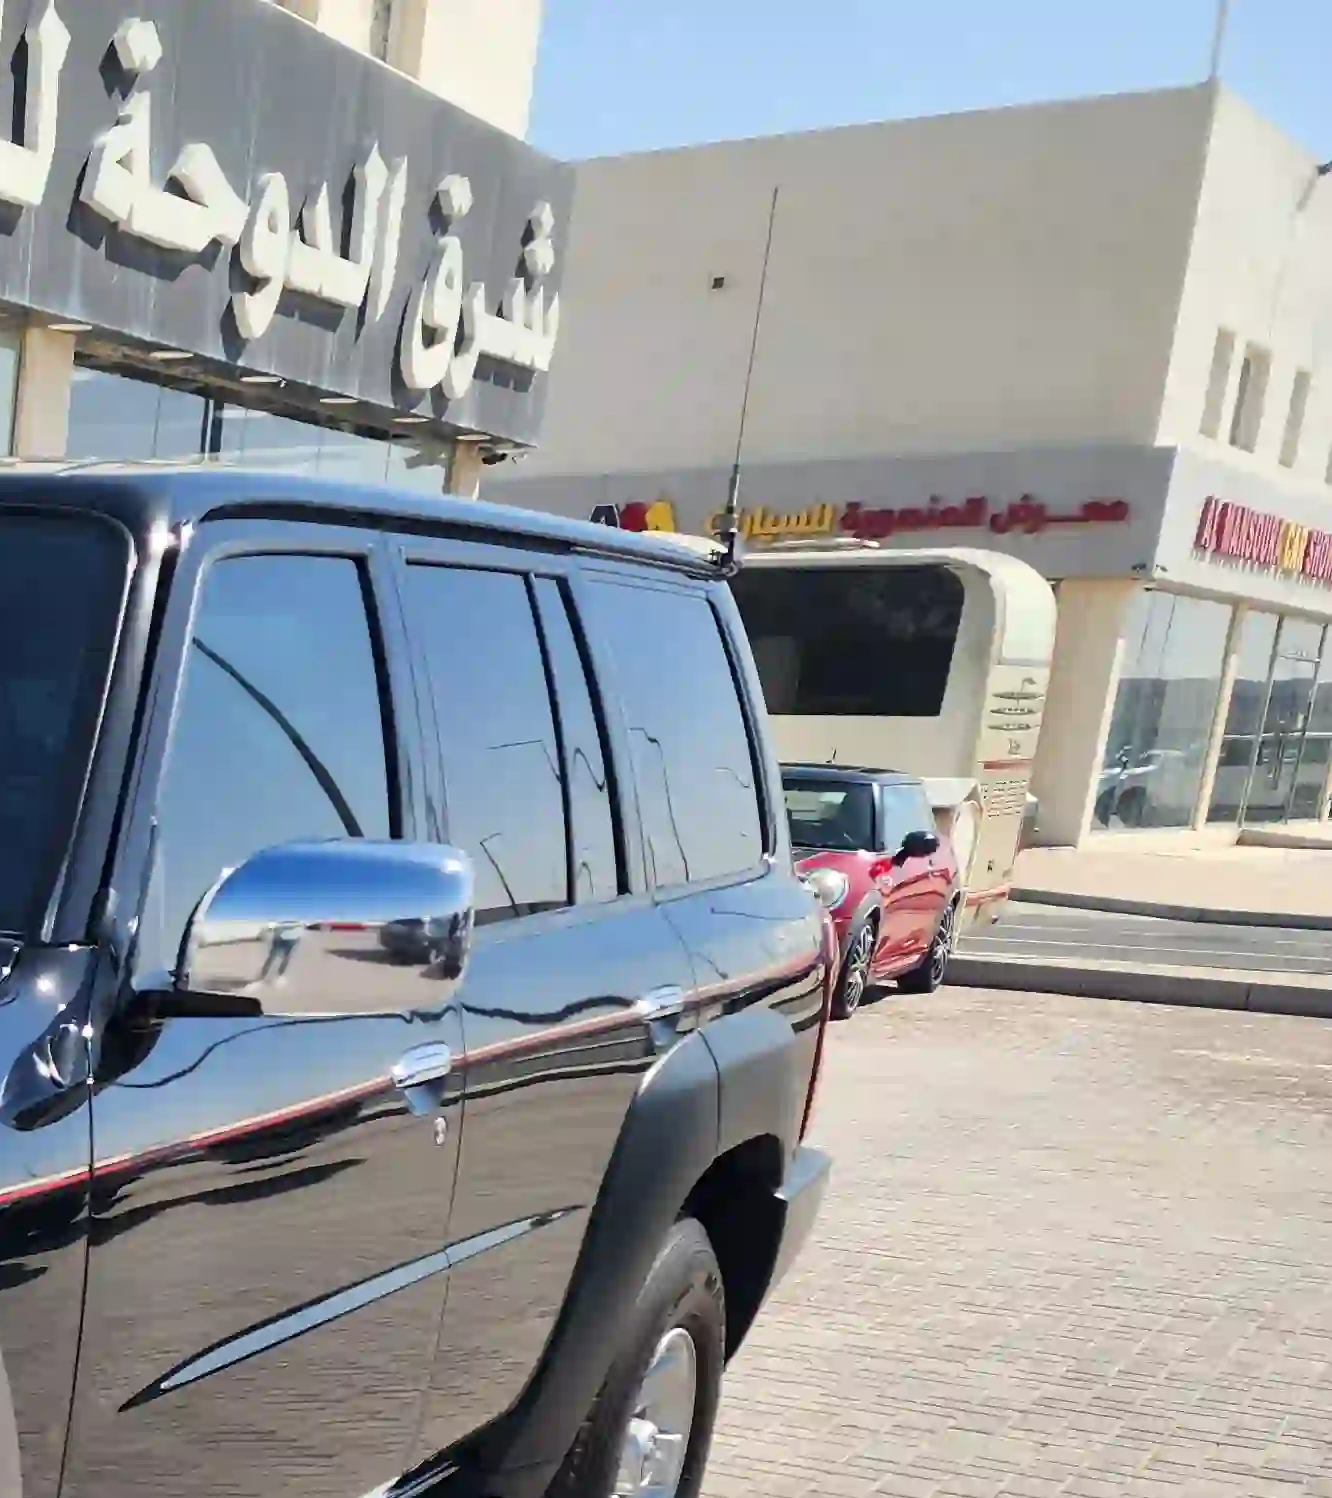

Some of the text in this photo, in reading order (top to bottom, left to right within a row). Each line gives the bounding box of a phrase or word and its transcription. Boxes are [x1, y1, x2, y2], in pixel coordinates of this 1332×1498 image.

[78, 16, 409, 340] الدوحة
[400, 172, 560, 400] شرق
[988, 494, 1129, 535] معرض
